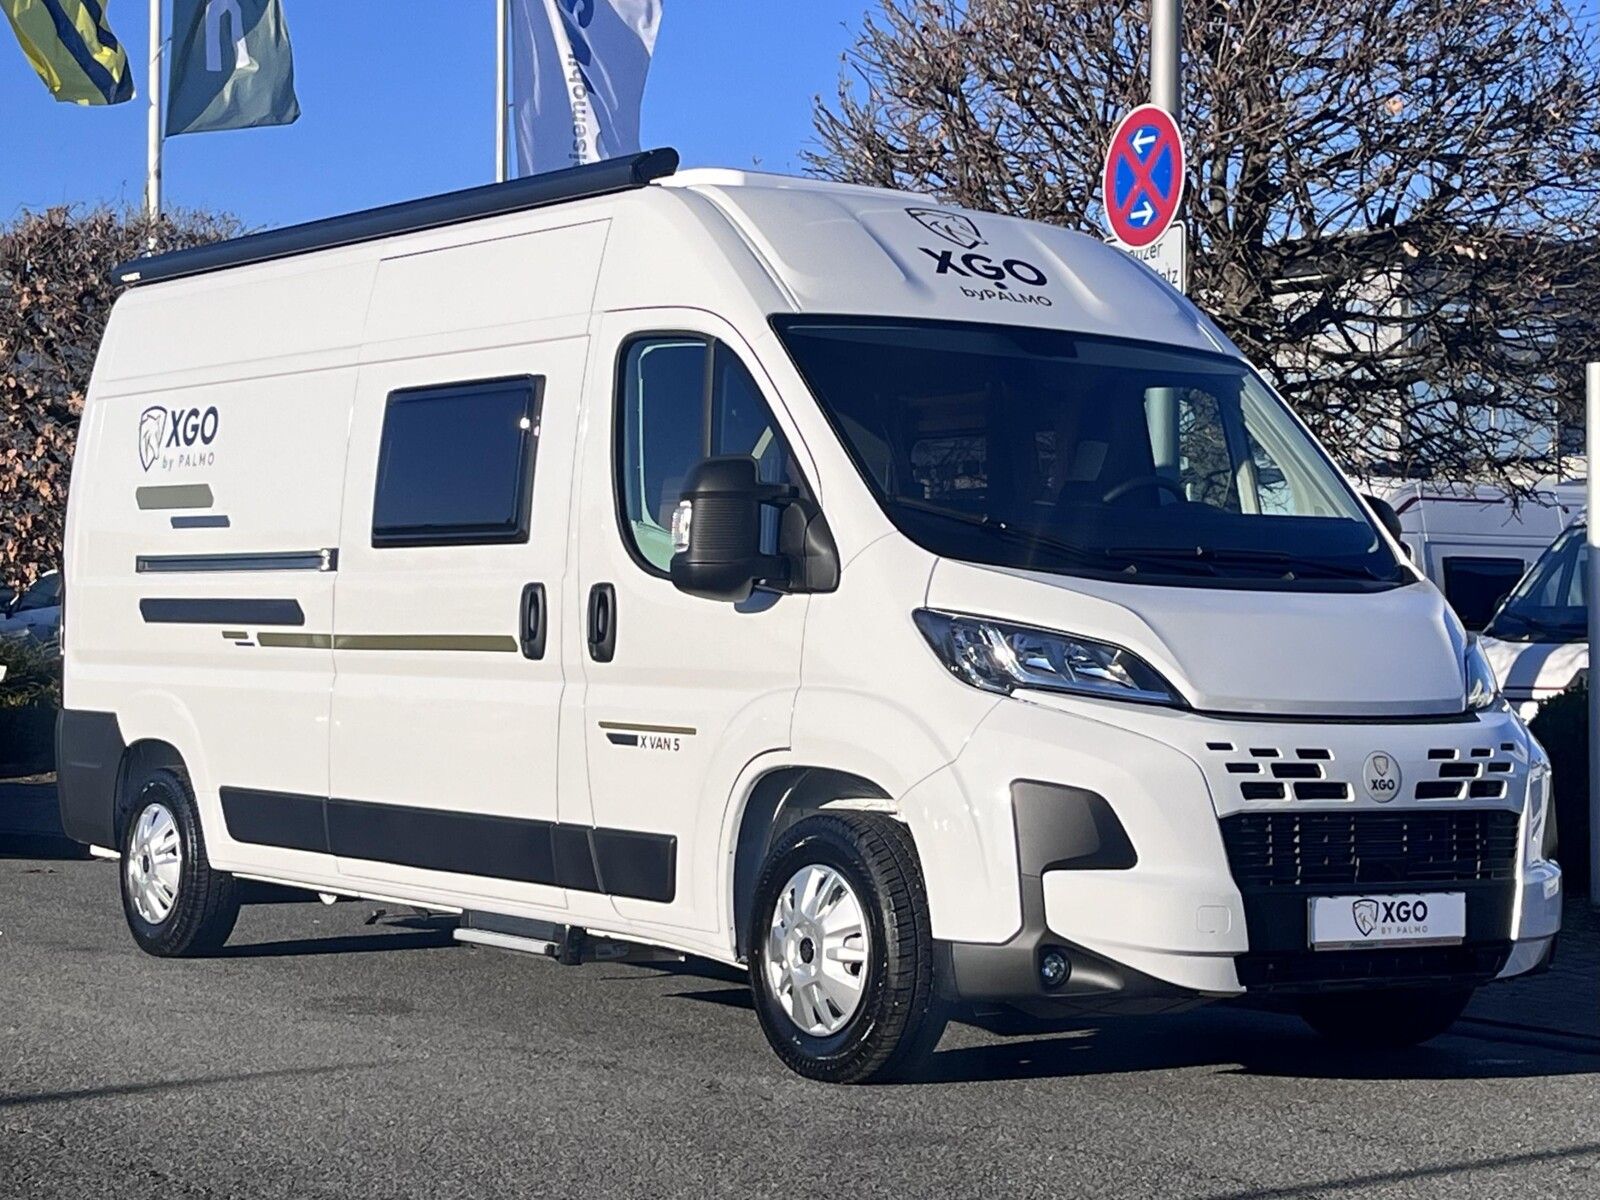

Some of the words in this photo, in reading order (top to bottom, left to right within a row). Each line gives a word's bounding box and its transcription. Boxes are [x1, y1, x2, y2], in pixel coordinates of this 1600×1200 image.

[917, 247, 1048, 287] XGO
[165, 406, 219, 449] XGO
[162, 455, 174, 472] by
[178, 452, 215, 468] PALMO
[640, 735, 648, 749] X
[649, 736, 672, 751] VAN
[673, 738, 681, 752] 5
[1371, 779, 1396, 791] XGO
[1381, 900, 1429, 924] XGO
[1381, 926, 1392, 935] BY
[1396, 925, 1429, 934] PALMO
